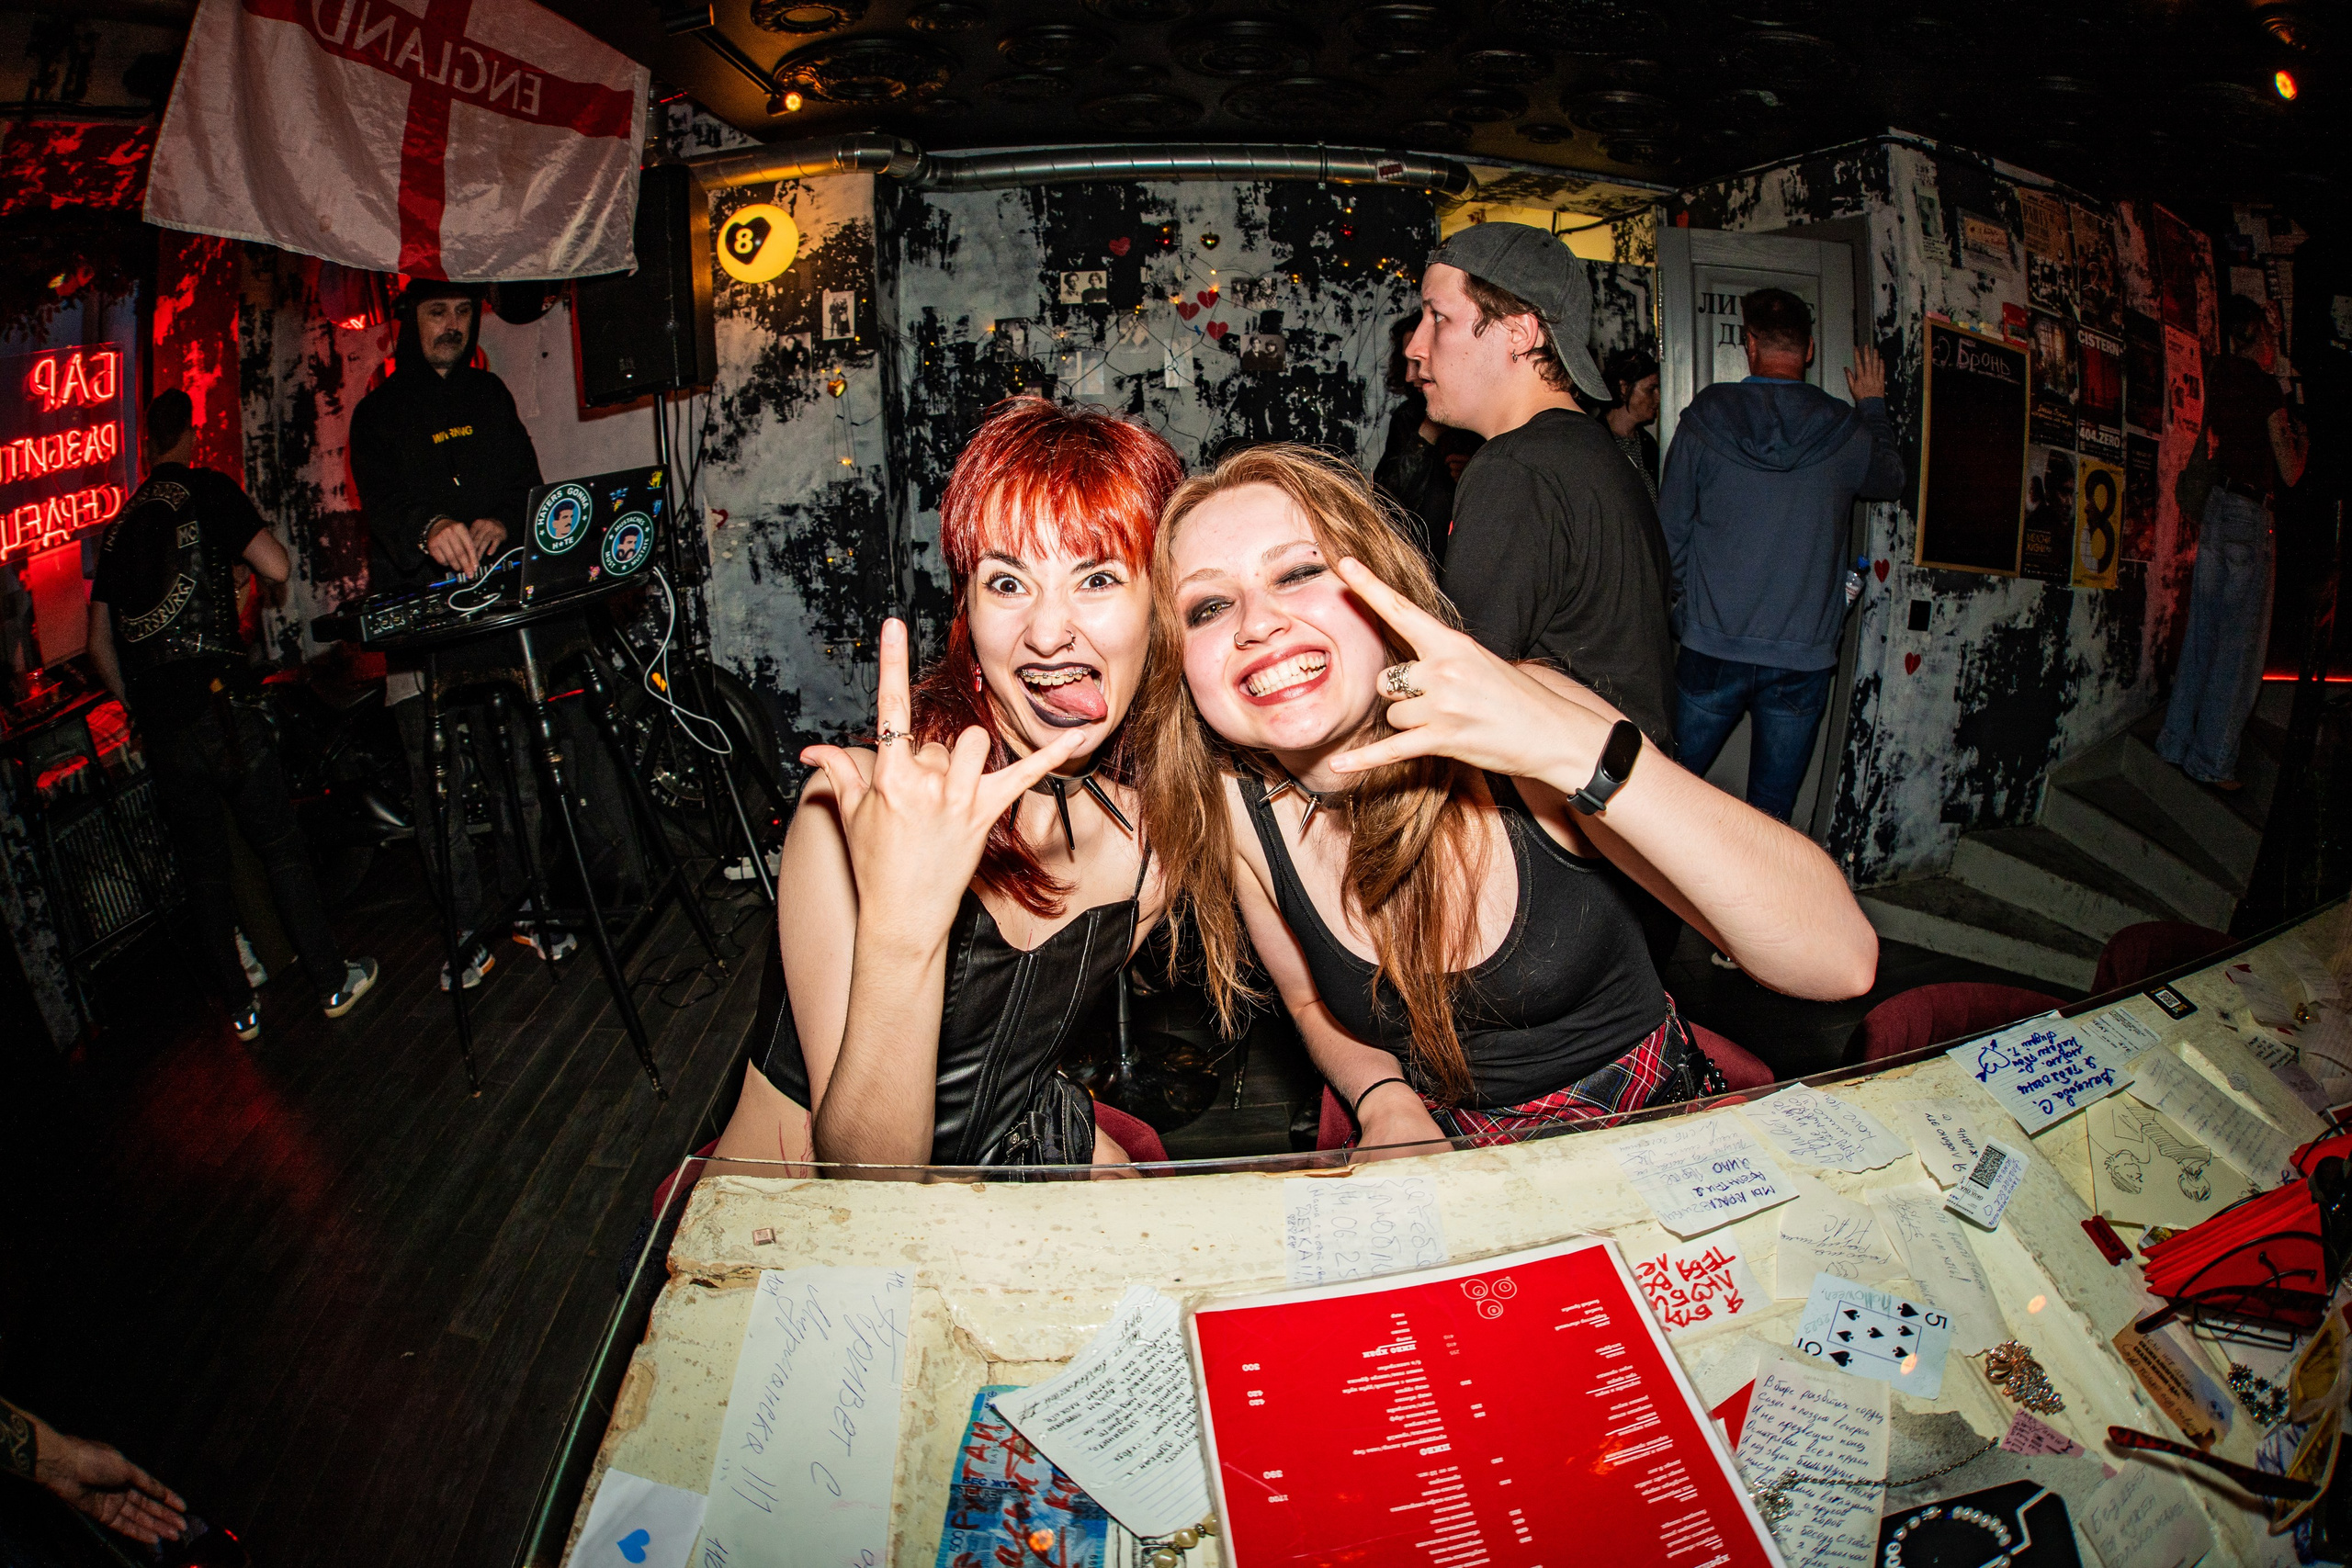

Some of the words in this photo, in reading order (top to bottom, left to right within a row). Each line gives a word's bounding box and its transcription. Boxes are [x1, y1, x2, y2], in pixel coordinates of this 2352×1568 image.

[734, 228, 754, 254] 8
[537, 490, 563, 525] HATERS
[566, 487, 590, 510] GONNA
[1676, 1247, 1736, 1281] ТЕБЯ
[1650, 1269, 1734, 1310] ЛЮБИ
[1724, 1289, 1744, 1314] Я
[1925, 1312, 1948, 1329] 5
